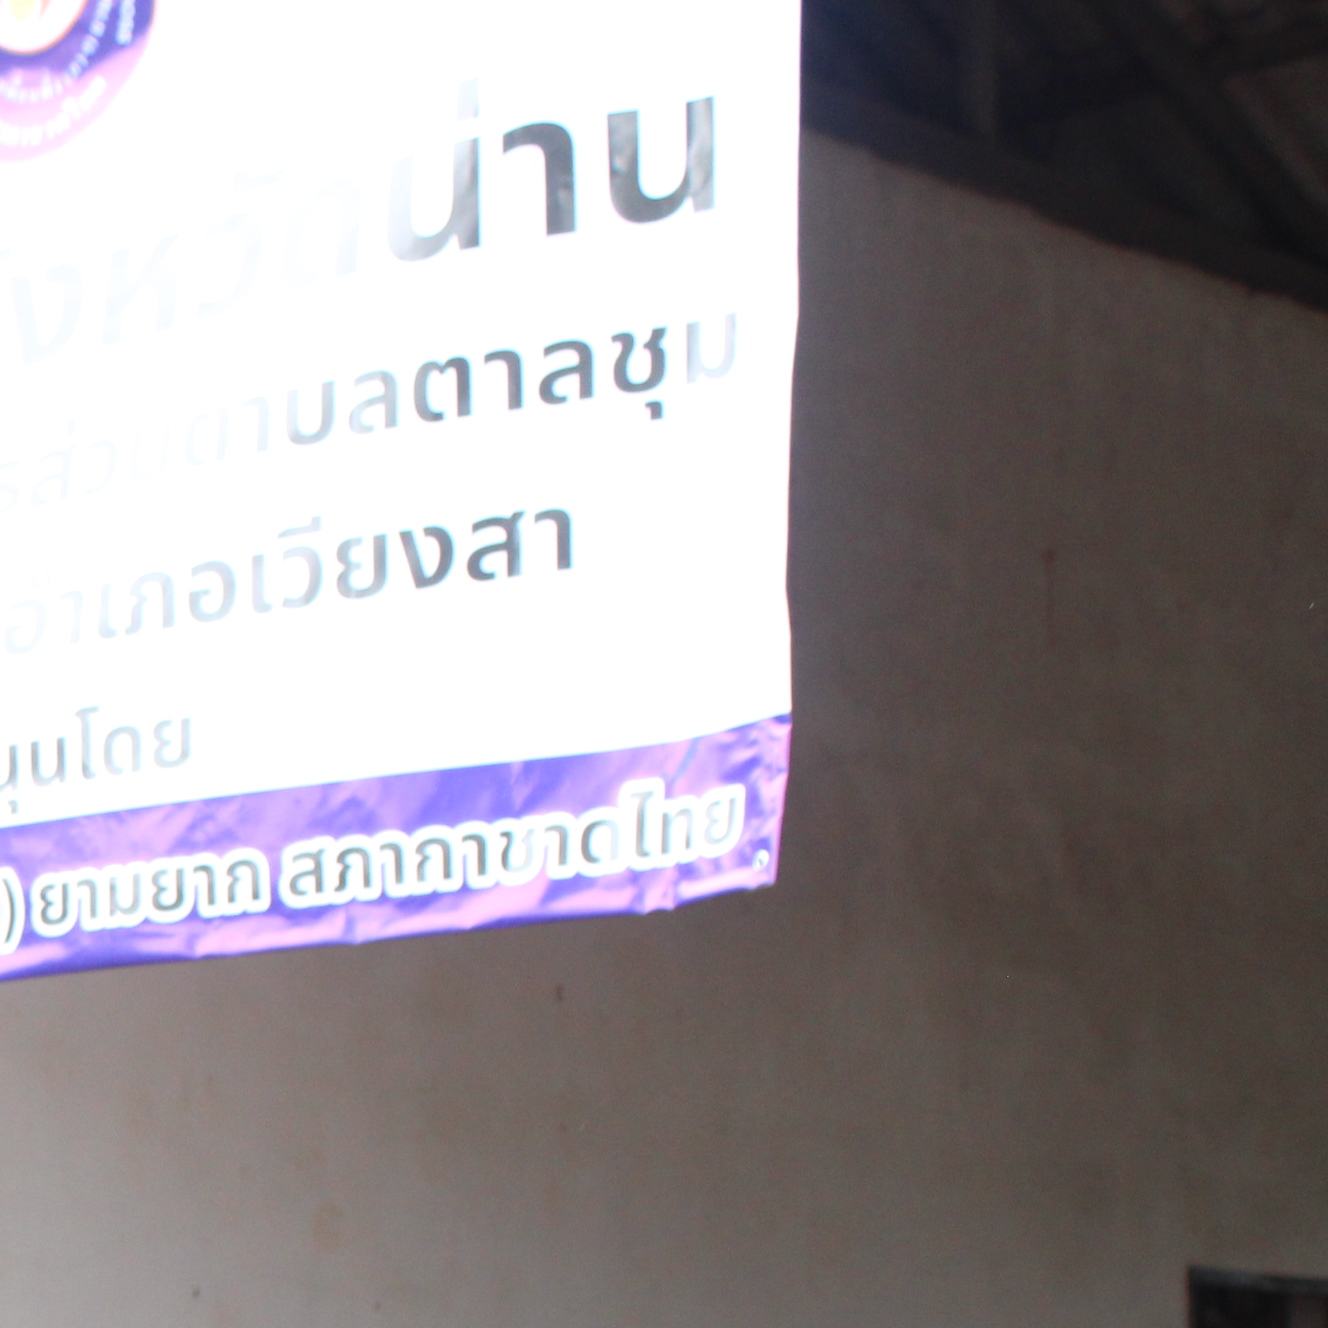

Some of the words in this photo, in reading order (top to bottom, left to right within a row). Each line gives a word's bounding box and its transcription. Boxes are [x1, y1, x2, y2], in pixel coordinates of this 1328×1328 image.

[3, 503, 578, 656] อำเภอเวียงสา
[39, 858, 261, 926] ยามยาก
[288, 790, 739, 895] สภากาชาดไทย
